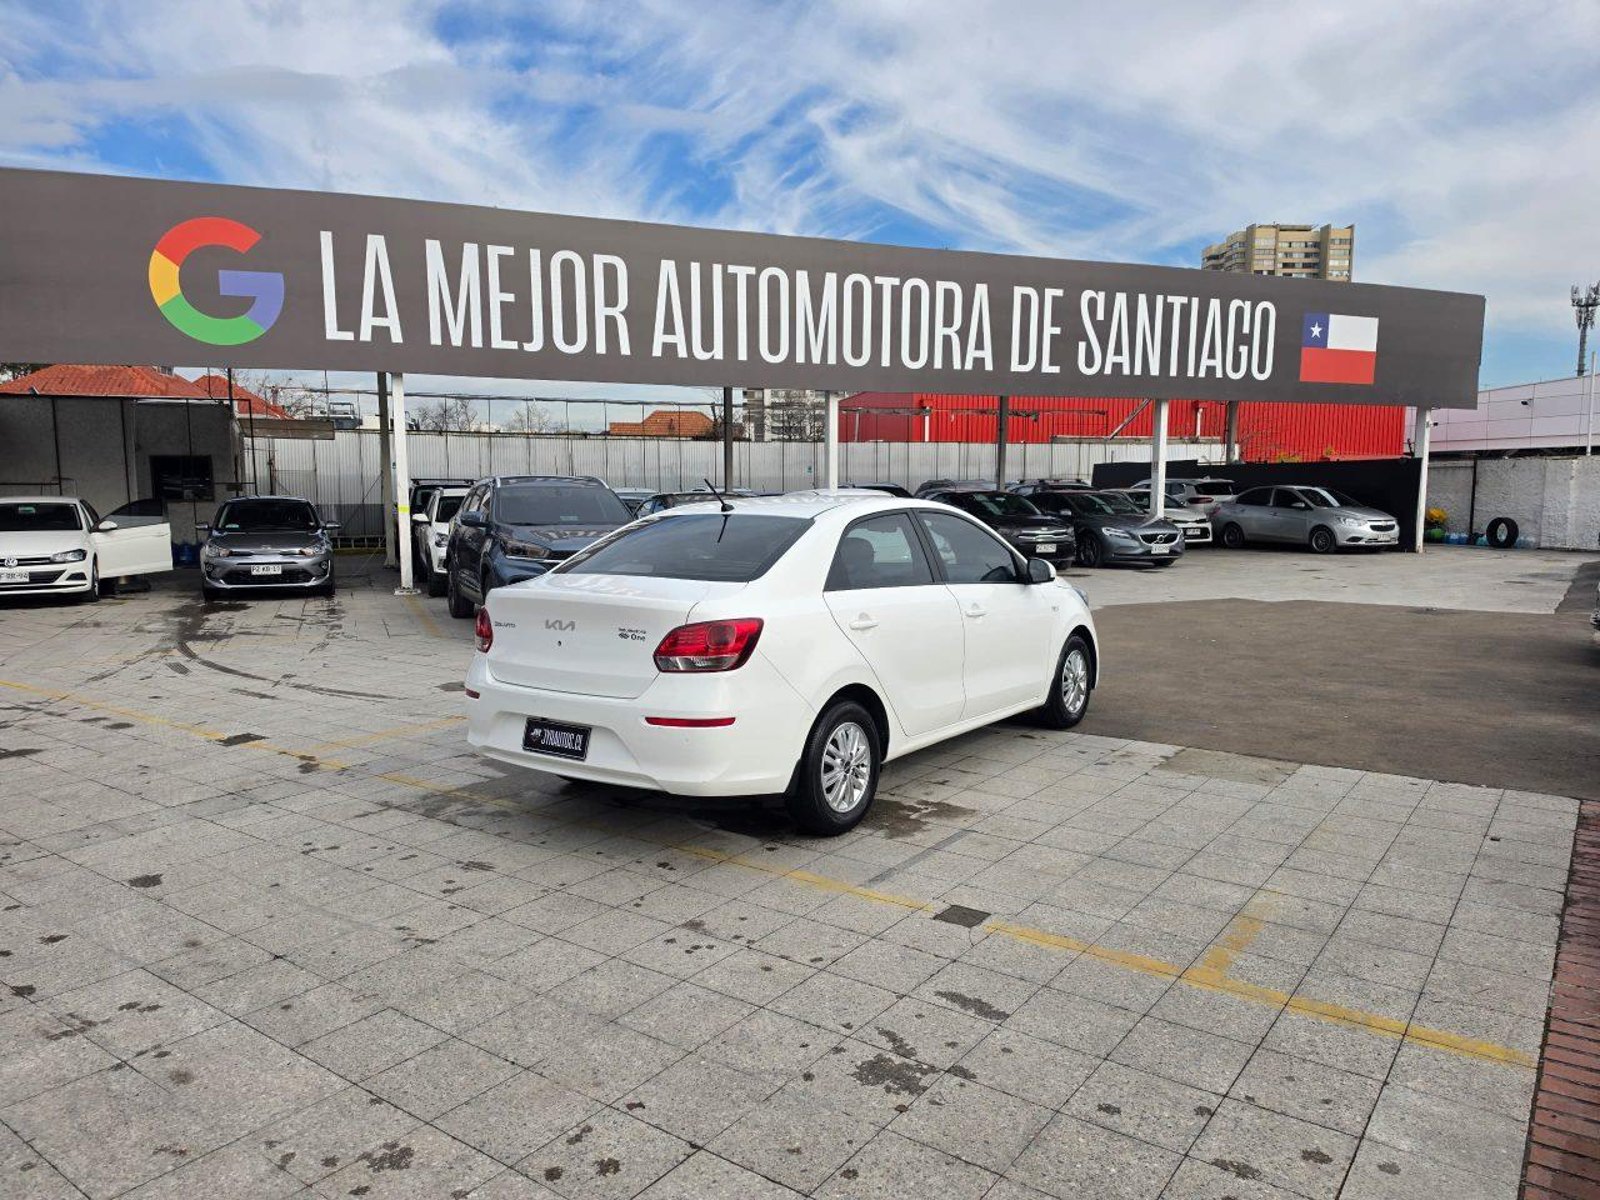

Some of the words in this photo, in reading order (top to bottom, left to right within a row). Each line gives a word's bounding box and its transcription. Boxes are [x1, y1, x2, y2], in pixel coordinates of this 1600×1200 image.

[320, 231, 403, 343] LA
[425, 239, 631, 356] MEJOR
[652, 259, 994, 372] AUTOMOTORA
[1010, 286, 1064, 375] DE
[1078, 289, 1276, 382] SANTIAGO
[544, 619, 576, 632] KIA
